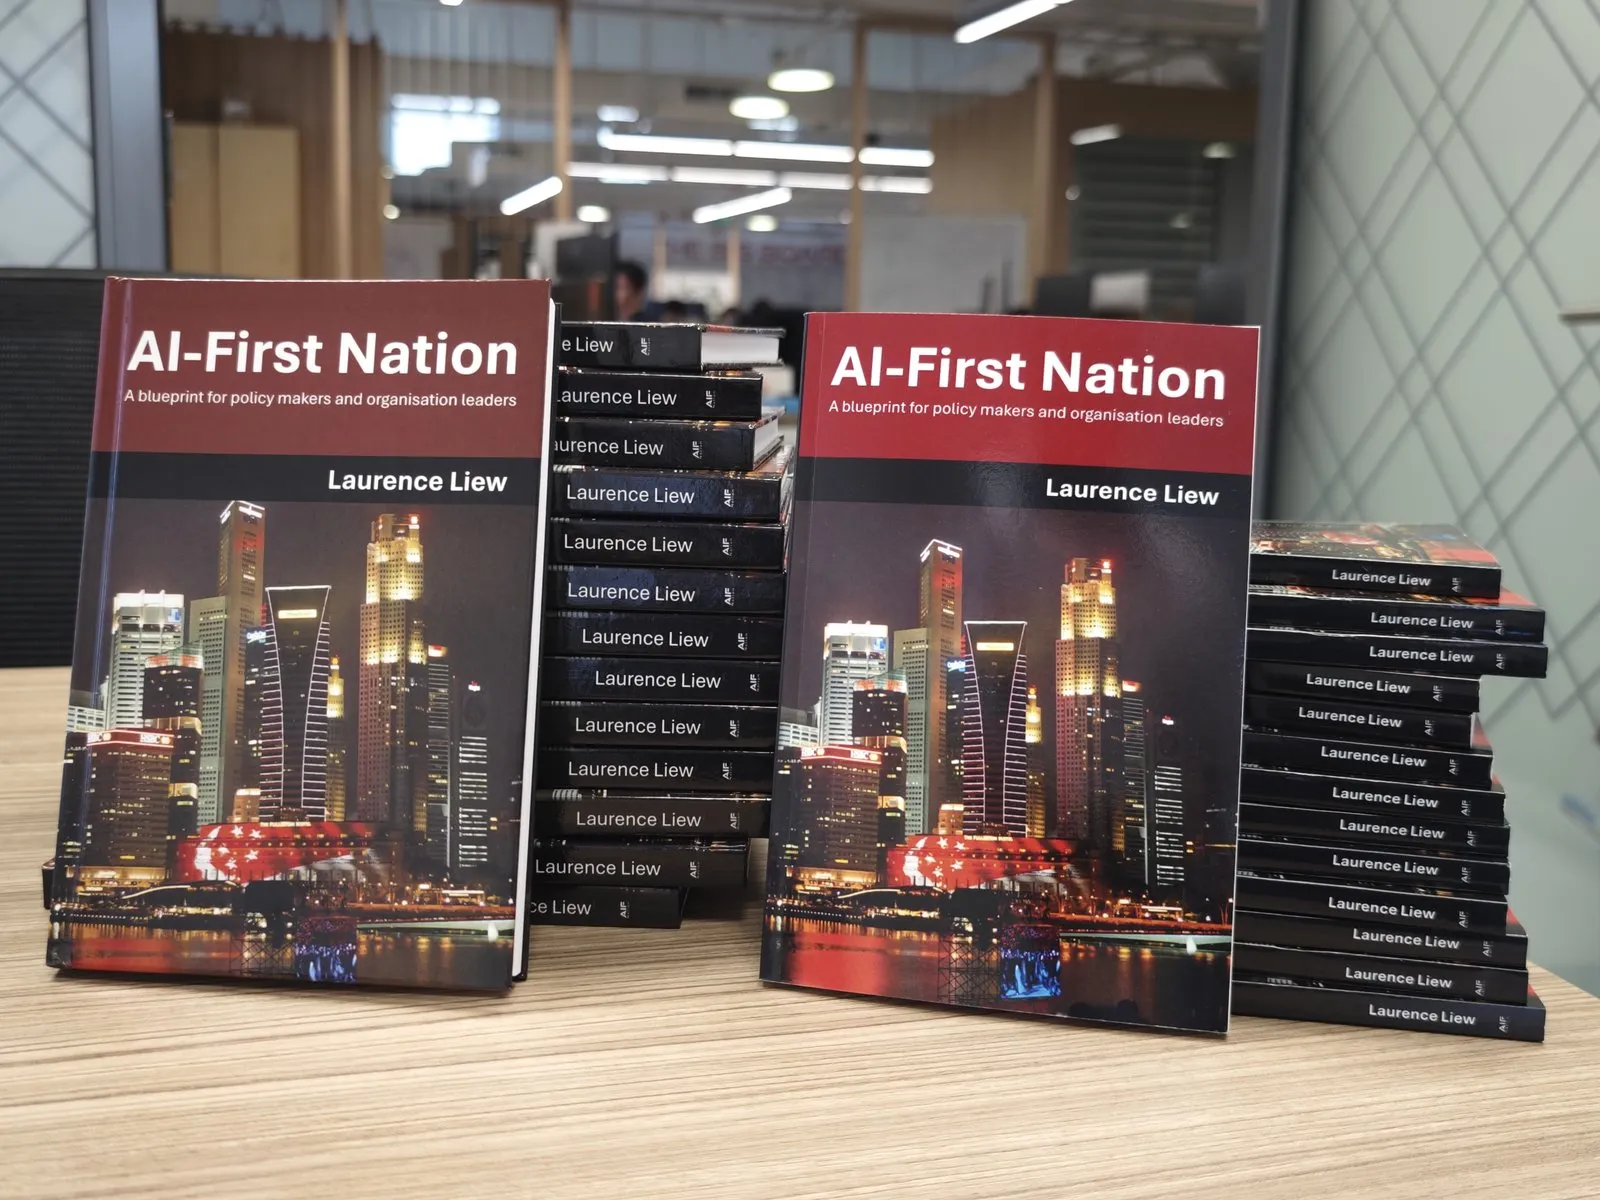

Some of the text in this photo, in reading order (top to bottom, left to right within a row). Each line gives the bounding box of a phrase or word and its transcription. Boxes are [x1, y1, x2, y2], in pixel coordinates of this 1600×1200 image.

[126, 329, 517, 375] AI-First Nation
[575, 336, 614, 353] Liew
[640, 337, 648, 356] AIF
[830, 346, 1225, 401] AI-First Nation
[123, 389, 517, 409] A blueprint for policy makers and organisation leaders
[557, 389, 678, 406] aurence Liew
[705, 390, 713, 408] AIF
[828, 399, 1224, 428] A blueprint for policy makers and organisation leaders
[624, 439, 664, 456] Liew
[692, 440, 700, 459] AIF
[328, 469, 508, 492] Laurence Liew
[567, 484, 695, 504] Laurence Liew
[723, 488, 732, 508] AIF
[1046, 478, 1220, 506] Laurence Liew
[564, 533, 693, 553] Laurence Liew
[722, 537, 730, 556] AIF
[1331, 569, 1431, 587] Laurence Liew
[568, 582, 696, 603] Laurence Liew
[724, 587, 733, 606] AIF
[1370, 611, 1474, 629] Laurence Liew
[582, 628, 709, 648] Laurence Liew
[737, 632, 745, 651] AIF
[1369, 645, 1474, 663] Laurence Liew
[595, 670, 722, 689] Laurence Liew
[749, 673, 757, 692] AIF
[1306, 673, 1411, 694] Laurence Liew
[575, 717, 702, 735] Laurence Liew
[1298, 706, 1403, 728] Laurence Liew
[729, 719, 737, 738] AIF
[1321, 745, 1427, 767] Laurence Liew
[568, 761, 694, 778] Laurence Liew
[722, 762, 730, 780] AIF
[1332, 786, 1439, 808] Laurence Liew
[576, 811, 702, 827] Laurence Liew
[729, 812, 738, 830] AIF
[1339, 818, 1445, 839] Laurence Liew
[535, 859, 661, 876] Laurence Liew
[689, 861, 697, 879] AIF
[1332, 854, 1439, 876] Laurence Liew
[552, 899, 592, 915] Liew
[619, 901, 627, 919] AIF
[1328, 896, 1436, 920] Laurence Liew
[1352, 928, 1460, 950] Laurence Liew
[1345, 966, 1453, 989] Laurence Liew
[1369, 1003, 1476, 1025] Laurence Liew
